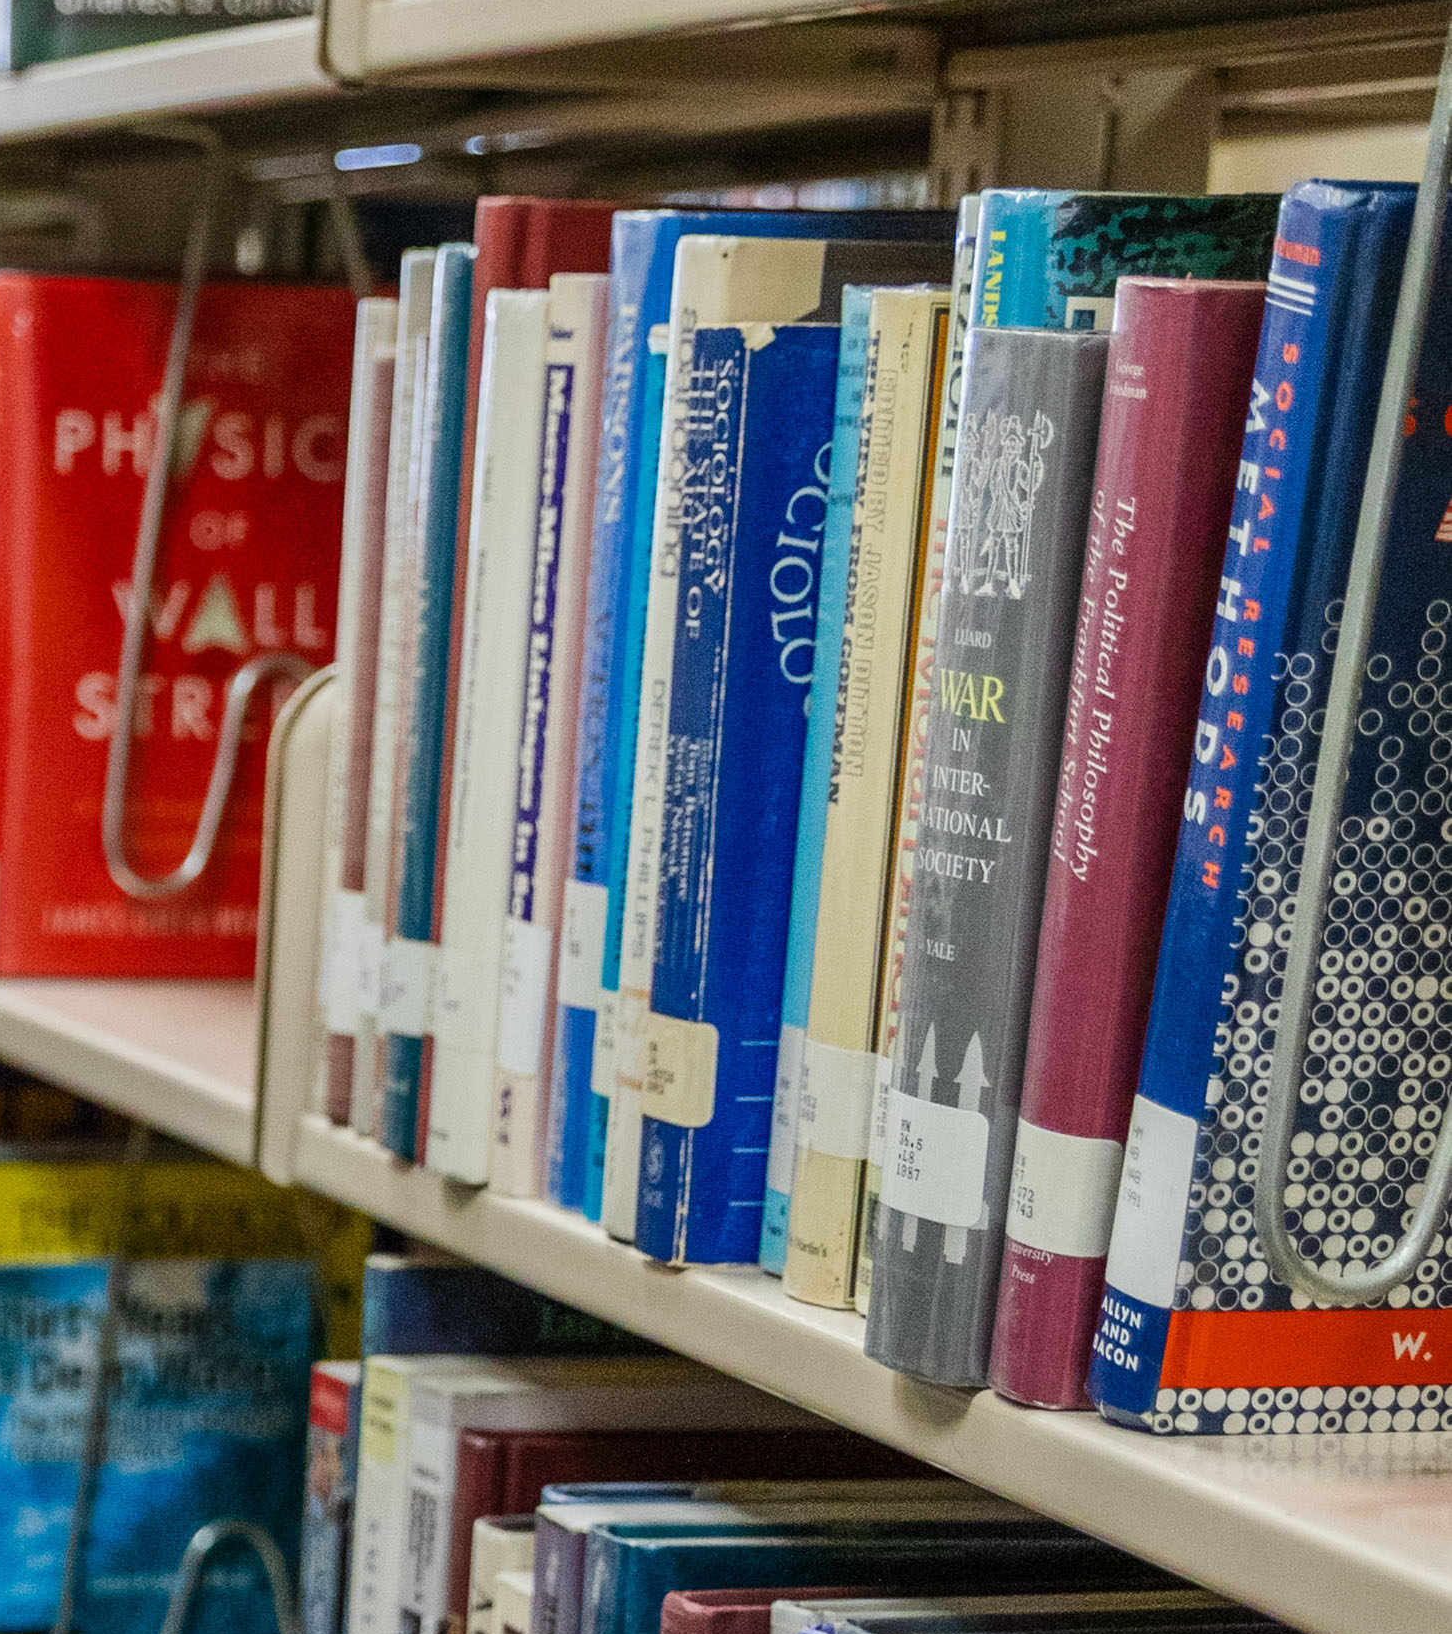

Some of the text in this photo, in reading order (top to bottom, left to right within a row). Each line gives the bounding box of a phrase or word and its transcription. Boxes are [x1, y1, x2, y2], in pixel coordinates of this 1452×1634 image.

[703, 358, 737, 595] SOCIOLOGY
[844, 368, 899, 777] EDITED BY JASON DITTON
[1181, 378, 1271, 825] METHODS
[1200, 343, 1300, 890] SOCIAL RESEARCH
[953, 628, 993, 650] LUARD
[828, 524, 864, 806] FROM GOFFMAN
[1051, 489, 1106, 863] of the Frankfurt School
[938, 668, 1008, 725] WAR
[1069, 496, 1137, 882] The Political Philosophy
[951, 727, 973, 753] IN
[932, 764, 991, 798] INTER-
[917, 807, 1013, 843] NATIONAL
[917, 846, 996, 885] SOCIETY
[925, 937, 957, 963] YALE
[1100, 1296, 1143, 1330] ALLYN
[1101, 1319, 1131, 1347] AND
[1093, 1333, 1140, 1374] BACON
[1391, 1330, 1433, 1363] W.
